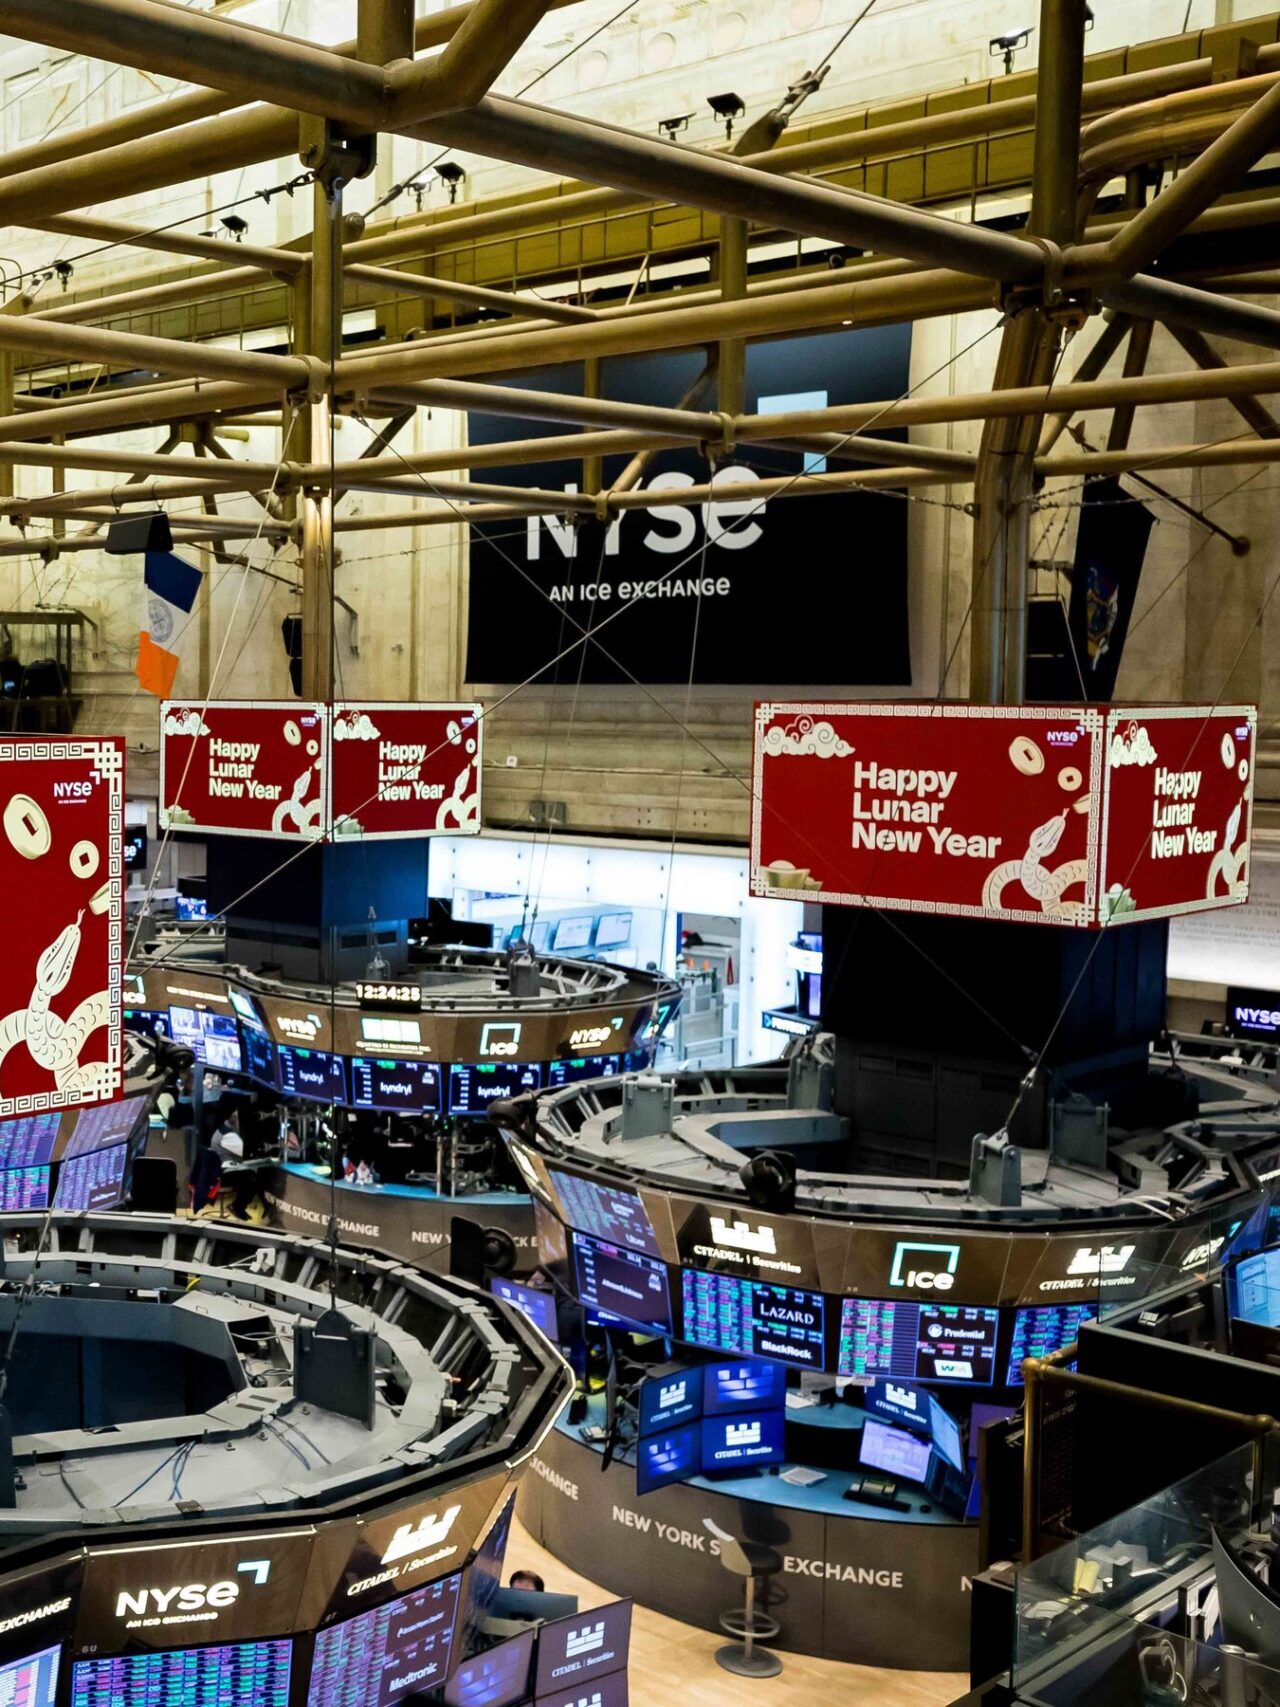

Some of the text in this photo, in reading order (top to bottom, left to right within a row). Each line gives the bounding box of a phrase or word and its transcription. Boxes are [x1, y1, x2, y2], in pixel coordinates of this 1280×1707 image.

[549, 586, 574, 601] AN
[209, 738, 260, 761] Happy
[379, 741, 426, 763] Happy
[209, 761, 255, 779] Lunar
[378, 762, 421, 781] Lunar
[854, 761, 958, 798] Happy
[209, 778, 282, 800] New Year
[378, 781, 445, 801] New Year
[1154, 767, 1202, 800] Happy
[853, 792, 944, 824] Lunar
[1153, 799, 1195, 827] Lunar
[852, 821, 1002, 858] New Year
[1151, 826, 1217, 859] New Year
[356, 984, 421, 1000] 12:24:25
[299, 1070, 324, 1084] kyndryl
[380, 1081, 412, 1096] kyndryl
[477, 1086, 510, 1099] kyndryl
[293, 1206, 321, 1224] STOCK
[412, 1231, 442, 1244] NEW
[694, 1245, 802, 1274] CITADEL Securities
[1039, 1278, 1084, 1291] CITADEL
[760, 1303, 815, 1325] LAZARD
[944, 1328, 986, 1340] Prudential
[761, 1340, 813, 1360] BlackRock
[612, 1504, 652, 1532] NEW
[655, 1518, 706, 1553] YORK
[347, 1545, 458, 1597] CITADEL Securities
[783, 1555, 903, 1589] EXCHANGE
[552, 1651, 615, 1678] CITADEL Securities
[389, 1662, 438, 1693] Medtronic
